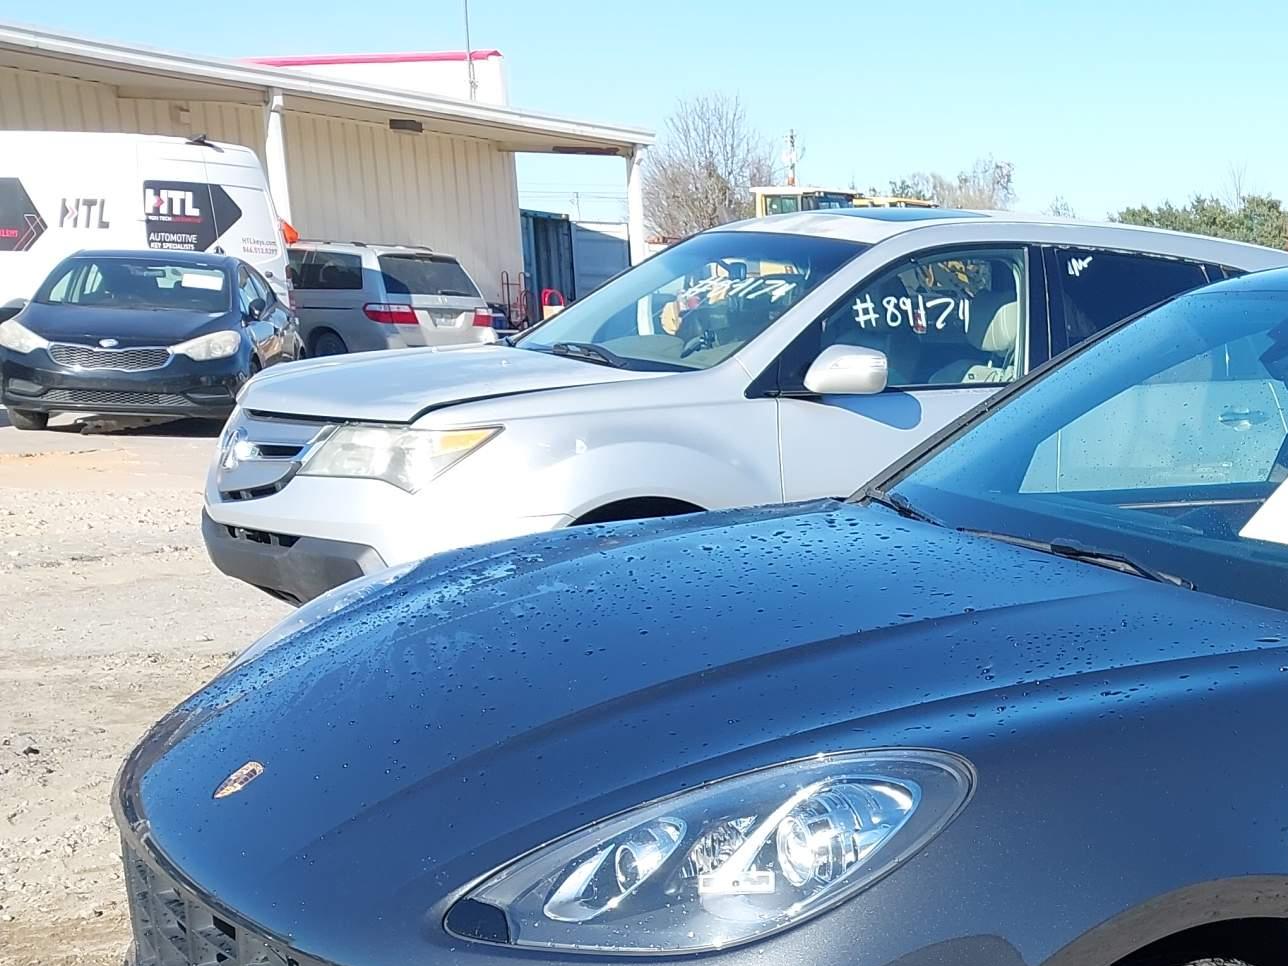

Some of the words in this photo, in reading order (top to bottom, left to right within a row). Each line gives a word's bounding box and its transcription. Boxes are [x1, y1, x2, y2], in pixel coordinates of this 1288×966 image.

[59, 197, 110, 229] HTL
[145, 188, 200, 216] HTL
[149, 232, 198, 244] AUTOMOTIVE
